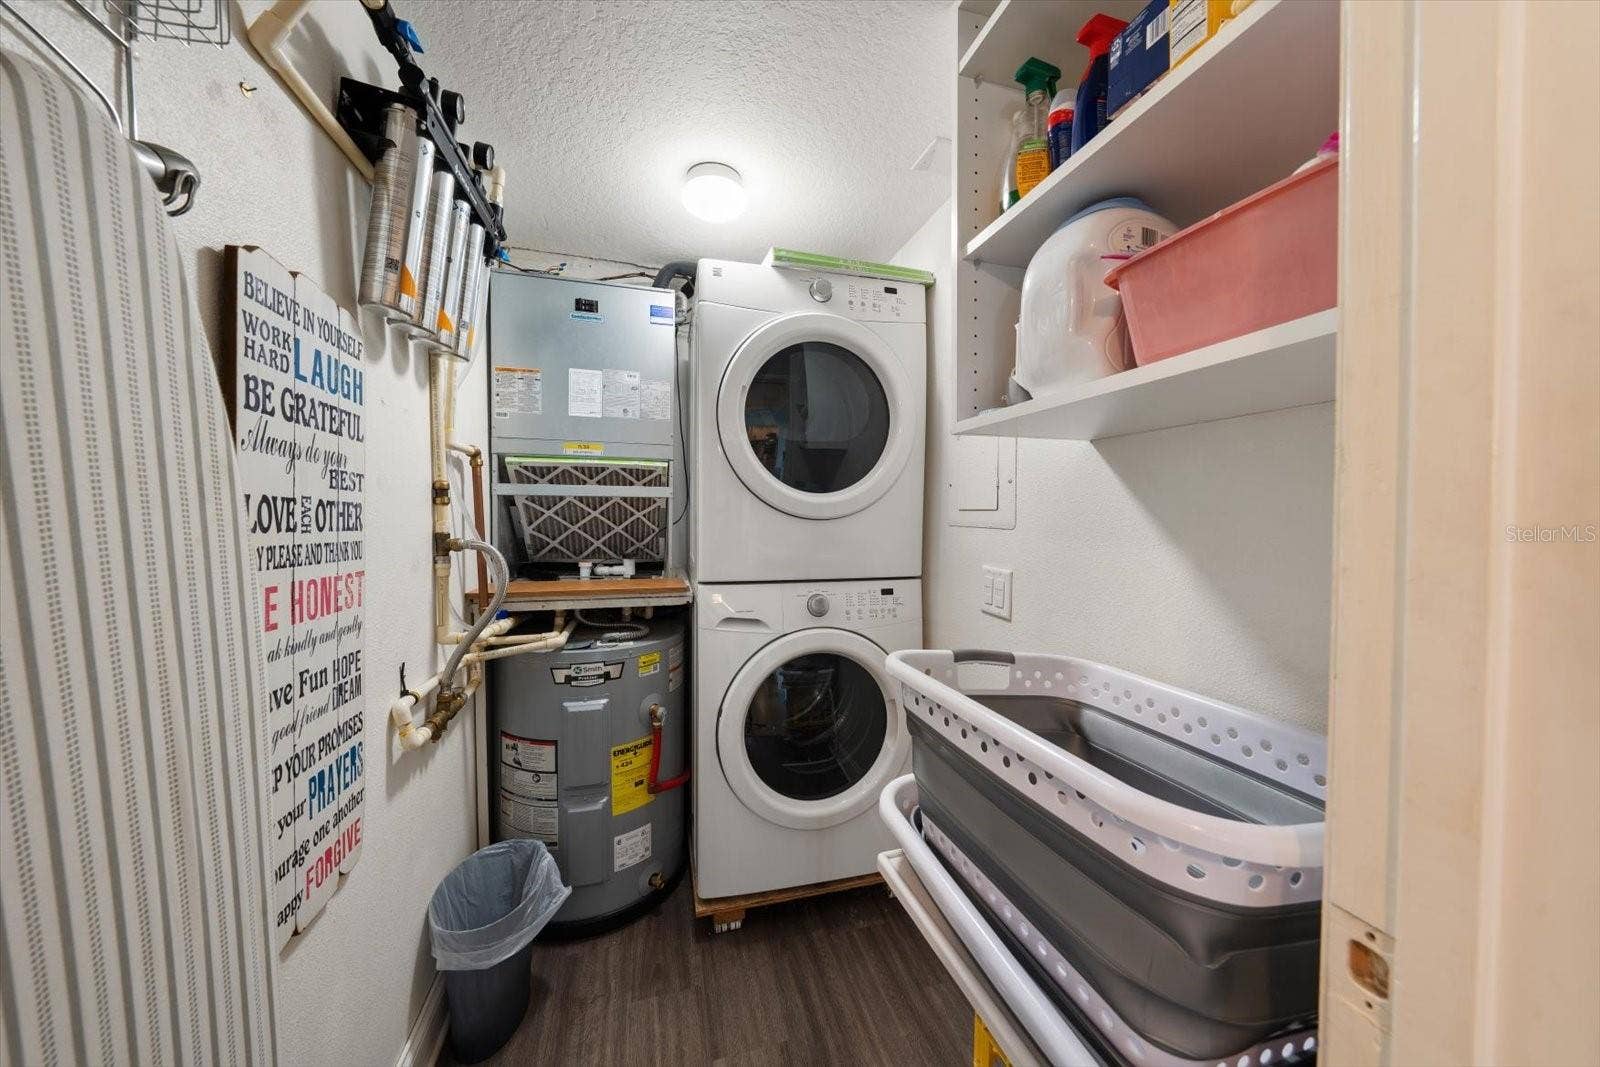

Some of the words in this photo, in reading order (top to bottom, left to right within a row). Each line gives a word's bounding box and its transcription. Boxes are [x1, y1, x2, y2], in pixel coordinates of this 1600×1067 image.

[242, 310, 292, 353] WORK
[244, 271, 300, 327] BELIEVE
[303, 306, 316, 332] IN
[317, 316, 363, 360] YOURSELF
[243, 336, 290, 375] HARD
[294, 337, 364, 406] LAUGH
[243, 374, 275, 417] BE
[281, 387, 364, 443] GRATEFUL
[241, 416, 302, 475] Always
[305, 433, 320, 463] do
[321, 448, 347, 479] your
[329, 469, 365, 492] BEST
[301, 495, 312, 534] EACH
[315, 498, 363, 533] OTHER
[266, 544, 303, 570] PLEASE
[304, 543, 323, 566] AND
[324, 541, 349, 563] THANK
[350, 540, 363, 561] YOU
[291, 570, 365, 626] HONEST
[284, 628, 317, 659] kindly
[319, 620, 338, 645] and
[299, 667, 328, 698] Fun
[333, 649, 361, 684] HOPE
[332, 673, 362, 711] DREAM
[272, 709, 300, 756] good
[285, 742, 315, 783] YOUR
[318, 711, 363, 761] PROMISES
[277, 799, 306, 840] your
[308, 741, 364, 820] PRAYERS
[313, 820, 331, 847] one
[332, 788, 364, 829] another
[305, 817, 361, 900] FORGIVE
